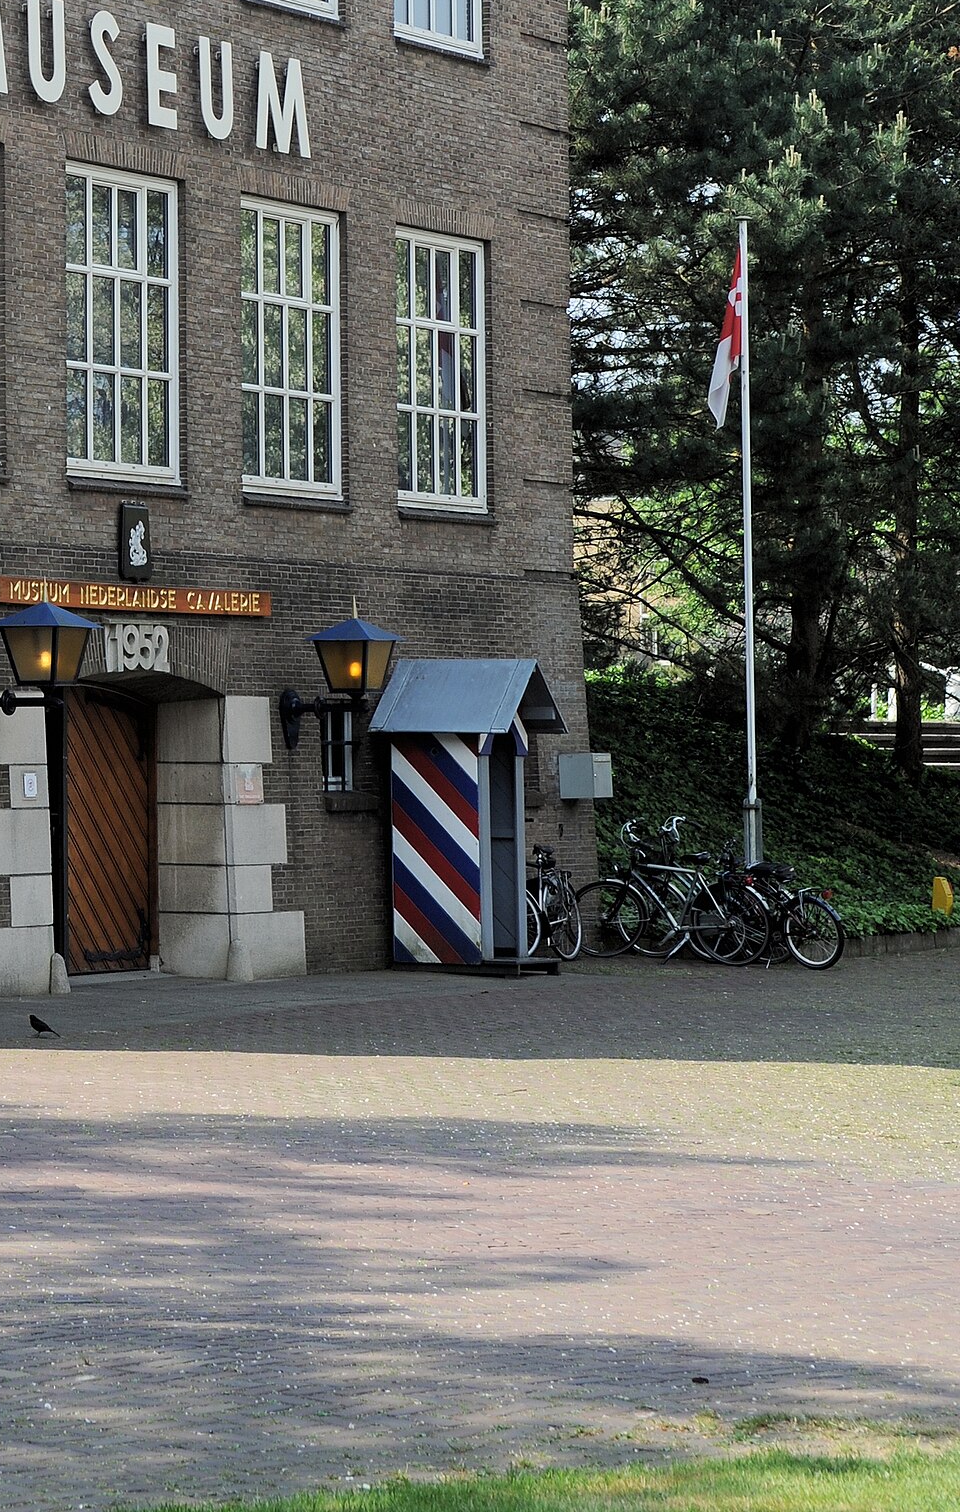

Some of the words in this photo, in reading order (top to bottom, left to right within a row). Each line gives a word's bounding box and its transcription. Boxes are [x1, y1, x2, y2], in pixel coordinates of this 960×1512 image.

[9, 580, 70, 604] MUSEUM
[80, 584, 176, 609] NEDERLANDSE
[187, 591, 260, 612] CAVALERIE
[105, 623, 171, 673] 1952
